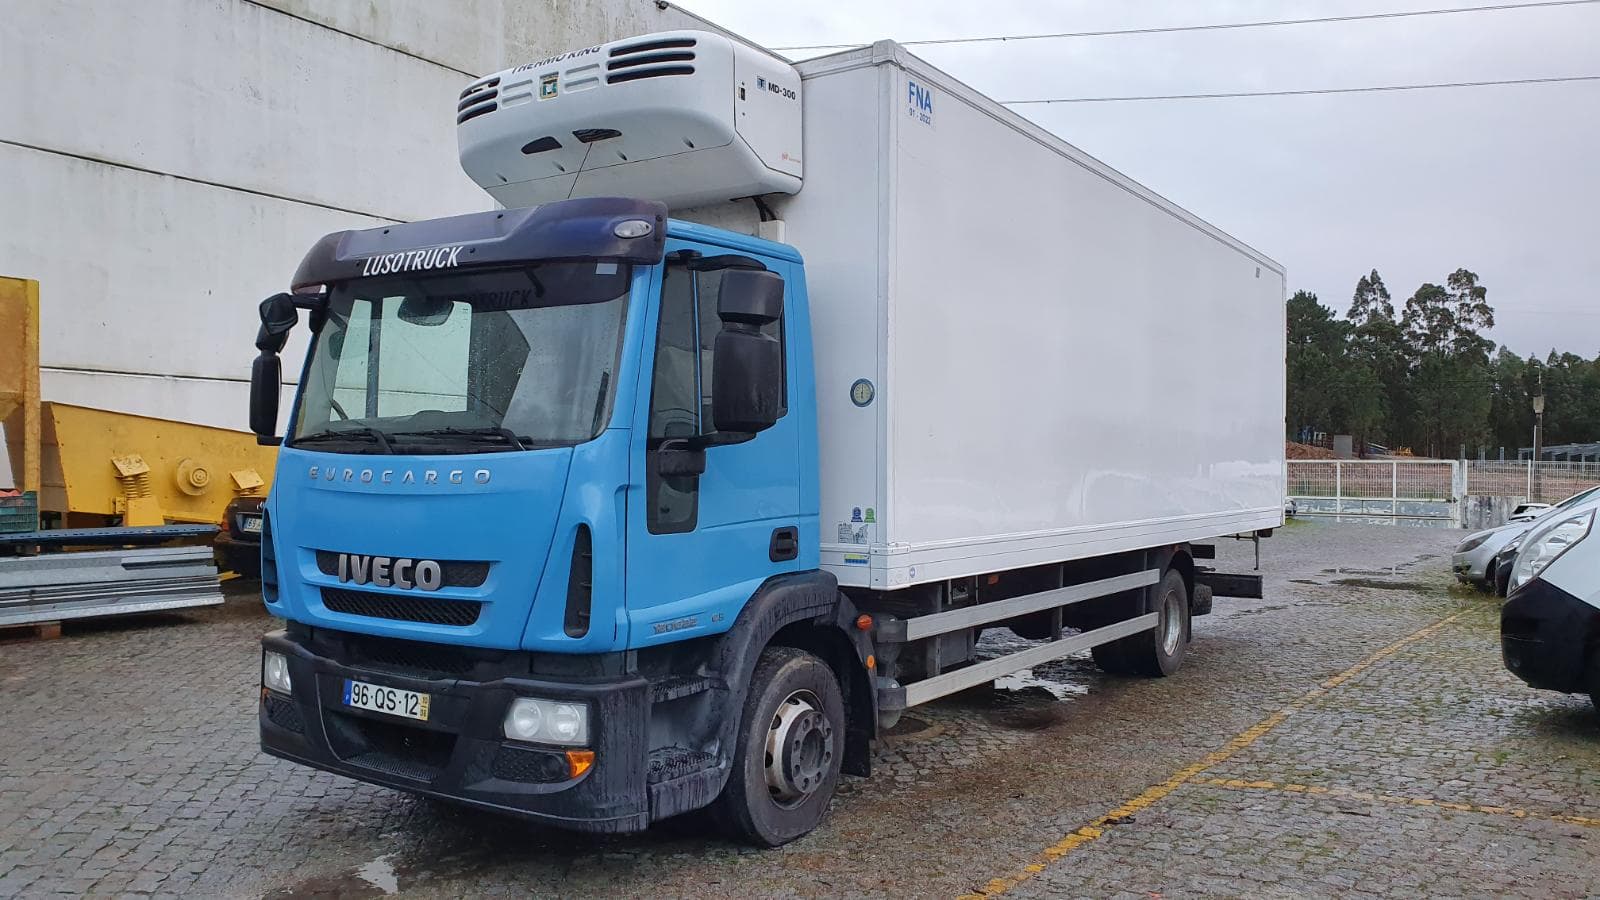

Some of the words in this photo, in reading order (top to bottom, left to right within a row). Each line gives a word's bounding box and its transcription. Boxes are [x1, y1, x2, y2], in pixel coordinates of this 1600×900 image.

[768, 82, 796, 100] MD-300
[909, 81, 932, 114] FNA
[362, 246, 464, 277] LUSOTRUCK
[308, 466, 492, 484] EUROCARGO
[338, 553, 442, 591] IVECO
